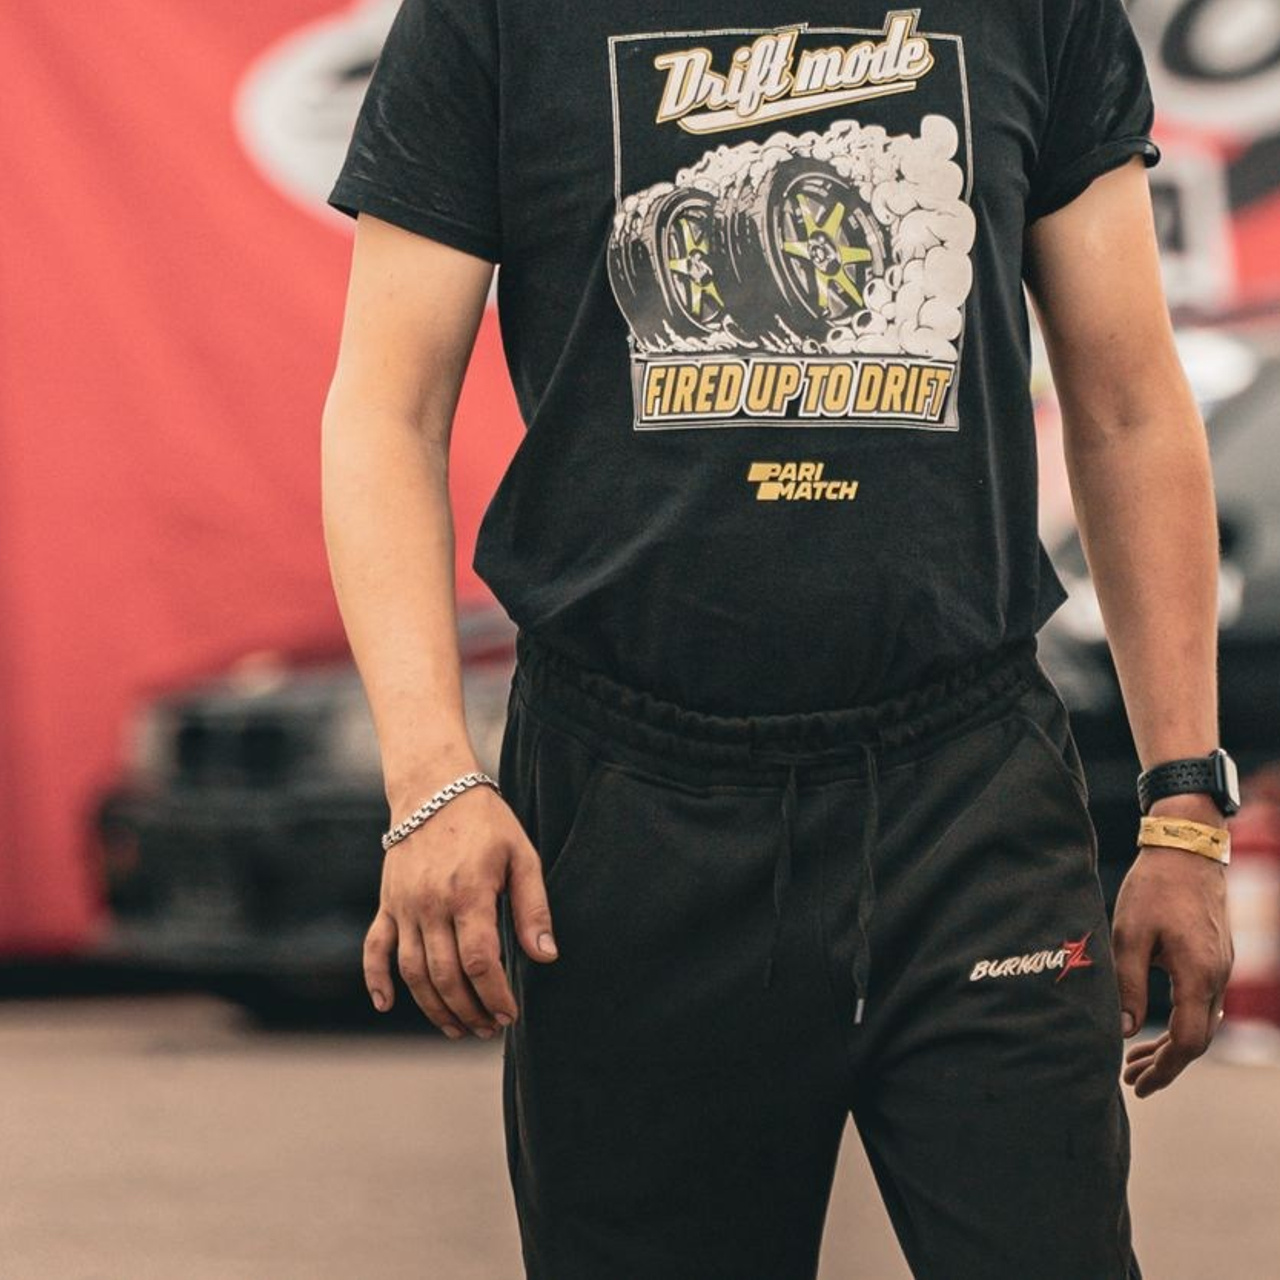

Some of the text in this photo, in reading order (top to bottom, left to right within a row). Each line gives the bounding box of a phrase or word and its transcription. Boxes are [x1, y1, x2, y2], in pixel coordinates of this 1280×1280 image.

[654, 14, 935, 124] Drift mode
[644, 363, 952, 419] FIRED UP TO DRIFT
[747, 462, 825, 482] PARI
[756, 481, 859, 501] MATCH
